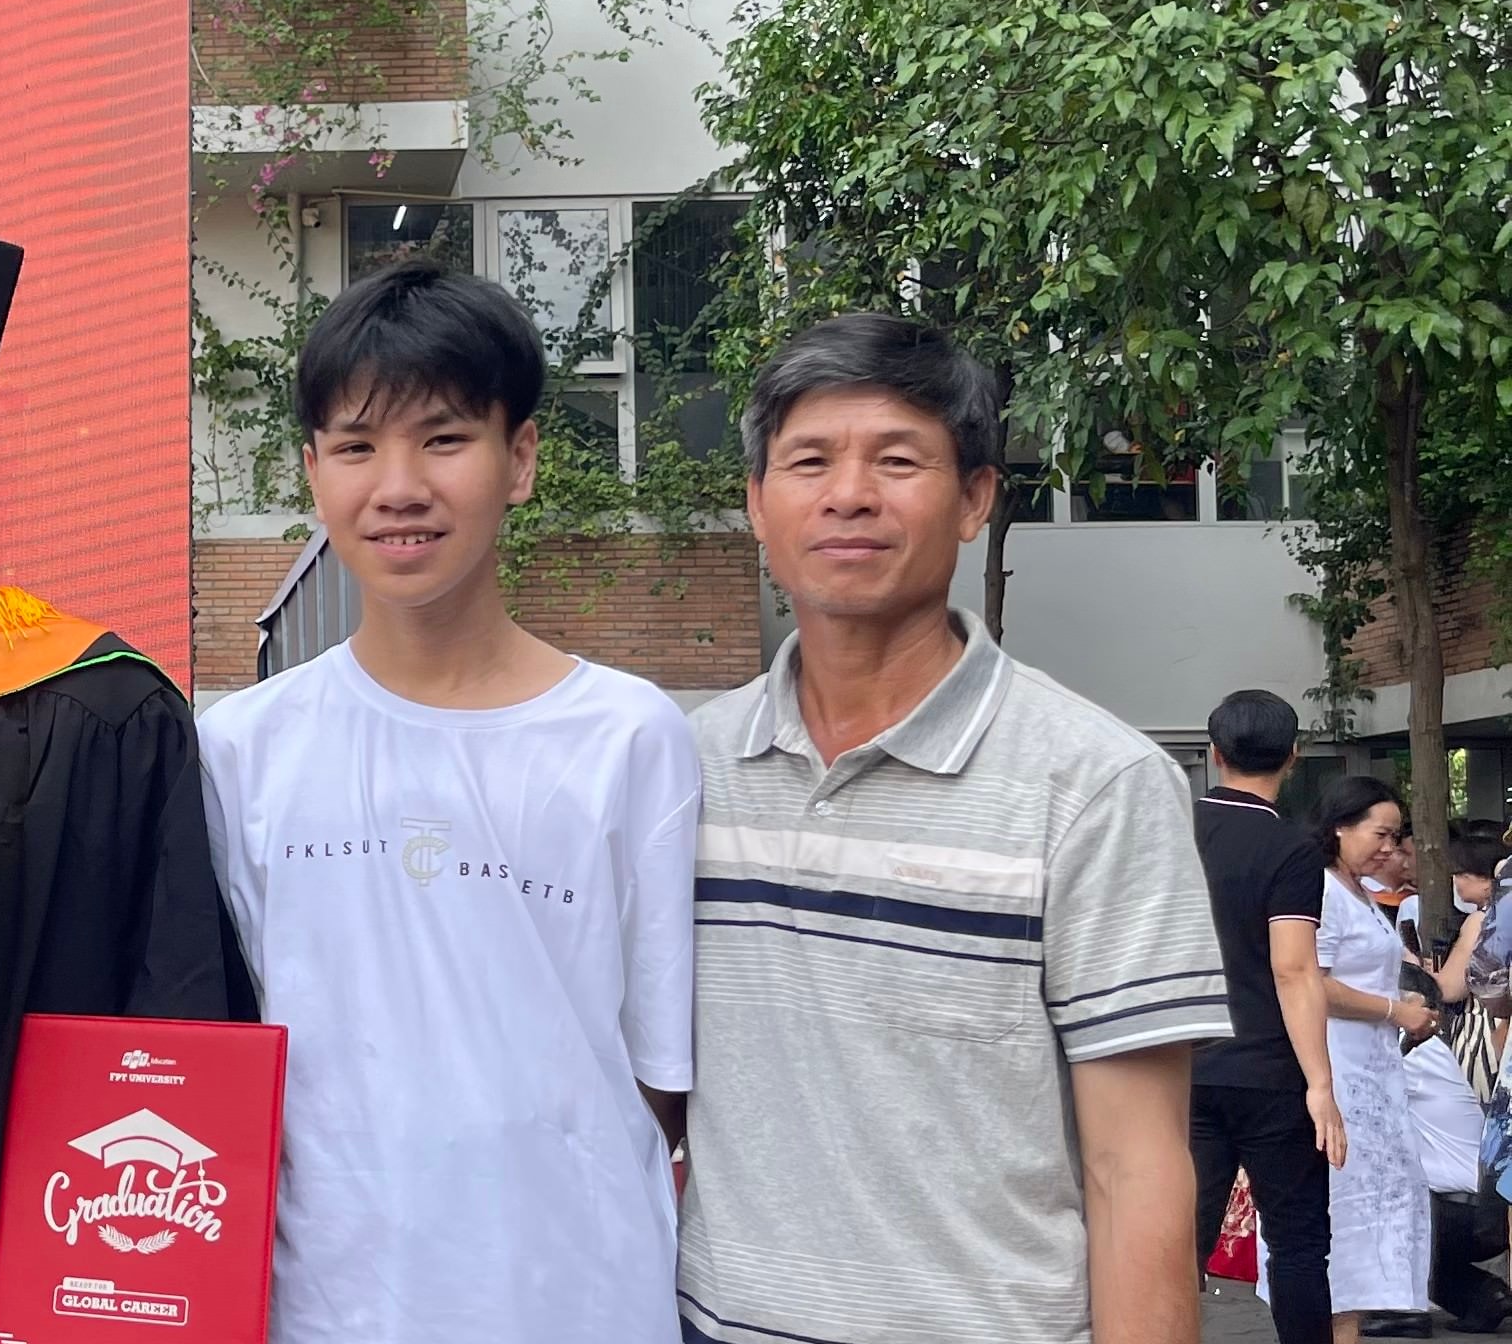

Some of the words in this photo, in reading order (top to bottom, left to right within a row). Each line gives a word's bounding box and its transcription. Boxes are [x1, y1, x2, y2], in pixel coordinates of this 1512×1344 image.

[109, 1072, 128, 1082] FPT
[129, 1073, 186, 1085] UNIVERSITY
[44, 1164, 227, 1246] Graduation
[62, 1295, 118, 1311] GLOBAL
[121, 1300, 178, 1317] CAREER
